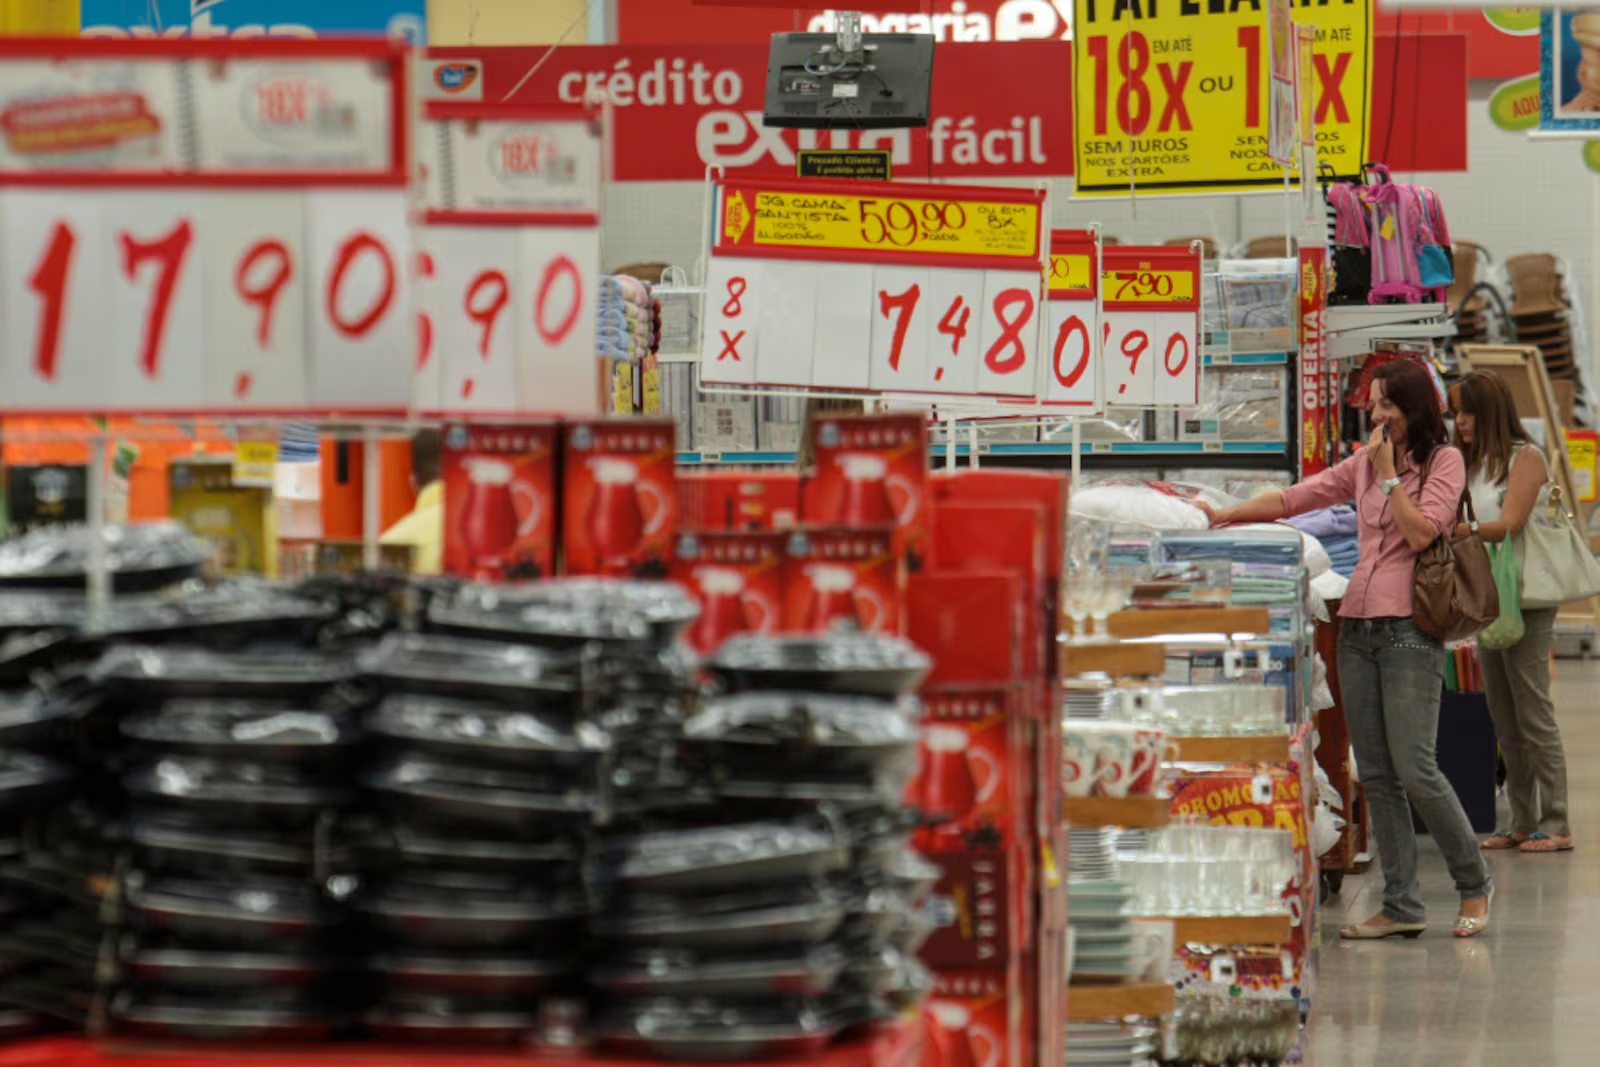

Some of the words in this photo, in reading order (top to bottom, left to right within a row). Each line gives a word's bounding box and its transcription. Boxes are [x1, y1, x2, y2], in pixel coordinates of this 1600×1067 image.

[558, 58, 743, 106] crédito
[1199, 75, 1234, 93] OU
[928, 117, 1046, 165] fácil
[1084, 141, 1122, 154] SEM
[1130, 137, 1188, 152] JUROS
[1085, 157, 1115, 167] NOS
[1120, 154, 1191, 165] CARTÕES
[1106, 166, 1165, 178] EXTRA
[791, 199, 847, 210] CAMA
[756, 209, 849, 222] SANTISTA
[721, 277, 747, 318] 8
[1303, 310, 1319, 411] OFERTA
